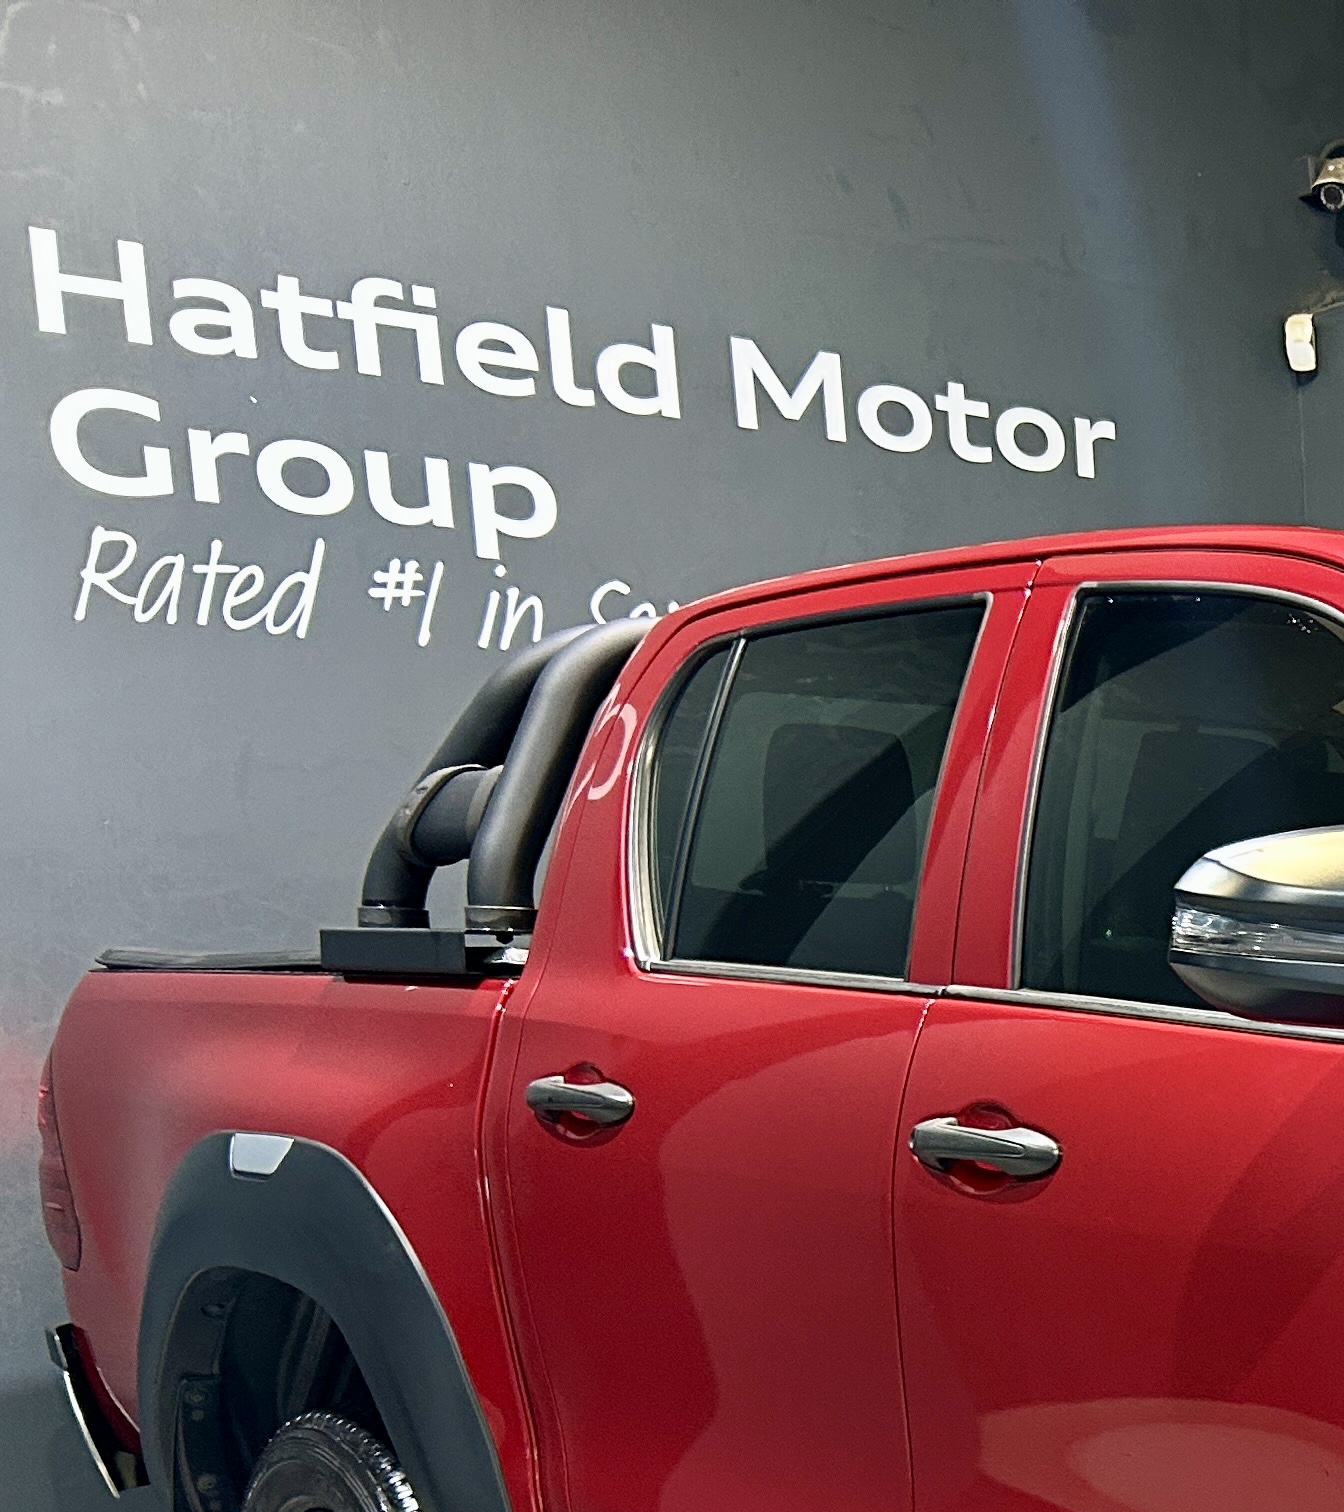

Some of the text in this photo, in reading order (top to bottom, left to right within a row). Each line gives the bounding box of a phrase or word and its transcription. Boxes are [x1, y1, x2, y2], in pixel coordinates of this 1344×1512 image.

[27, 225, 1117, 479] Hatfield Motor
[49, 386, 558, 560] Group
[73, 525, 327, 639] Rated
[476, 565, 545, 651] in
